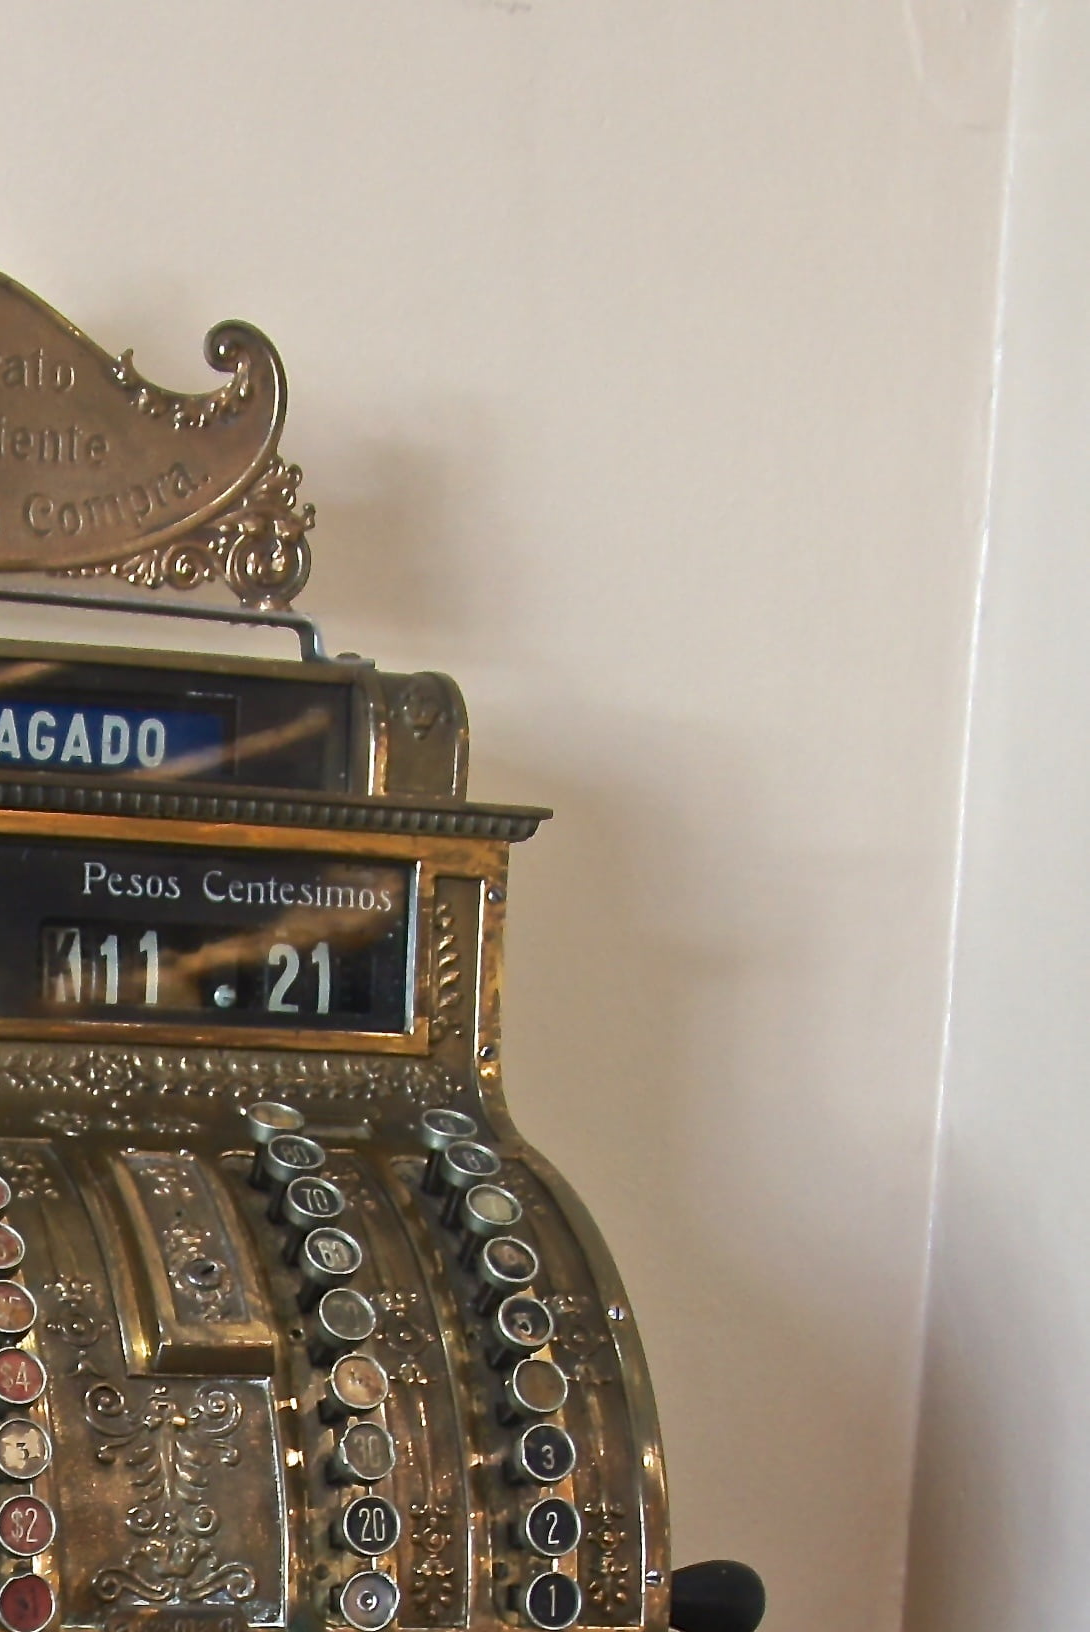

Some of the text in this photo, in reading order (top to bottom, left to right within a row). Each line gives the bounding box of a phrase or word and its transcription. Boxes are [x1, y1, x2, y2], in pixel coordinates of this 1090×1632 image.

[82, 861, 393, 912] Pesos Centesimos
[300, 1187, 330, 1212] 70
[541, 1444, 555, 1470] 3
[10, 1507, 39, 1543] $2
[358, 1507, 386, 1543] 20
[545, 1511, 561, 1545] 2
[548, 1584, 557, 1617] 1
